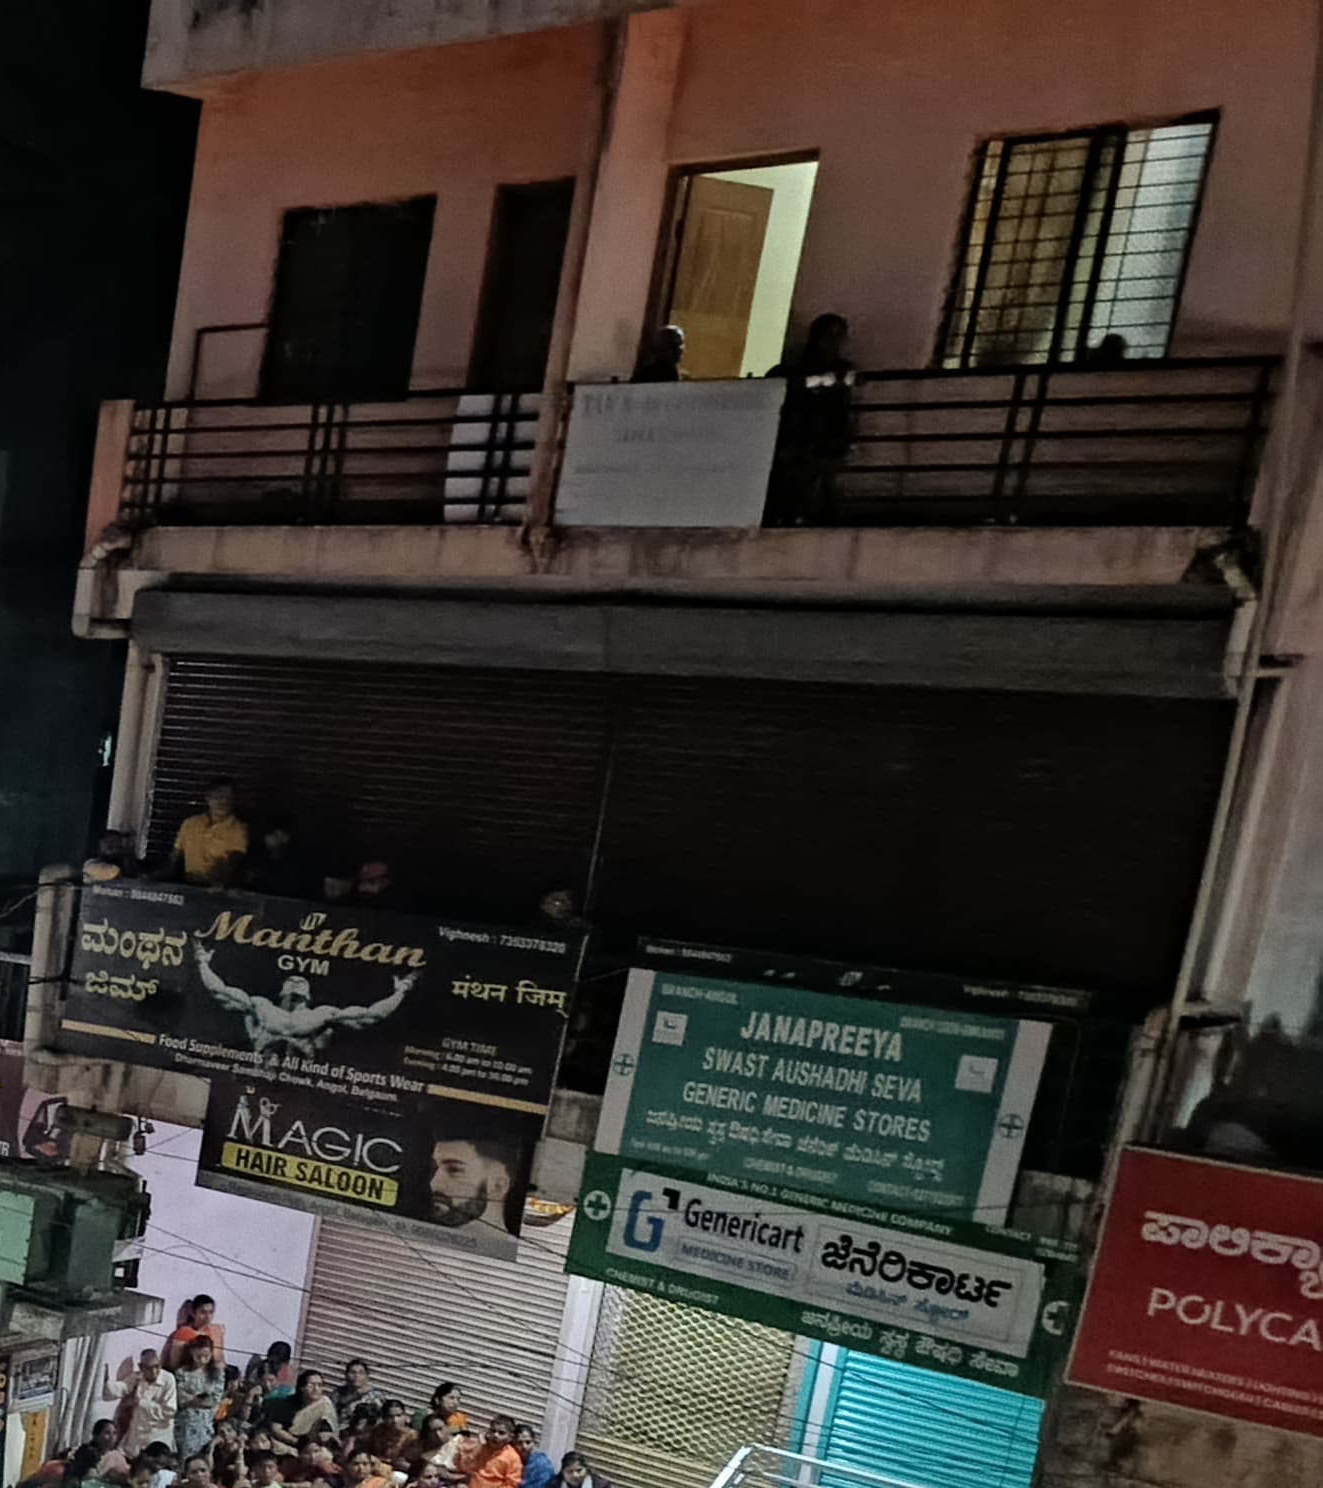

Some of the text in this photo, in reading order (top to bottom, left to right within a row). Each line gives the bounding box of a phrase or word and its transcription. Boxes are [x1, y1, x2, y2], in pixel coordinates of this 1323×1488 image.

[81, 918, 187, 970] ಮಂಥನ
[195, 911, 427, 968] Manthan
[276, 954, 330, 976] GYM
[85, 970, 159, 1001] ಜಿಮ್
[451, 974, 508, 1003] मंथन
[740, 1011, 902, 1062] JANAPREEYA
[159, 1033, 188, 1050] Food
[188, 1039, 264, 1065] Supplements
[282, 1055, 298, 1071] All
[300, 1058, 328, 1078] Kind
[330, 1061, 346, 1078] of
[346, 1066, 387, 1087] Sports
[390, 1074, 426, 1093] Wear
[703, 1047, 922, 1103] SWAST AUSHADHI SEVA
[227, 1095, 403, 1173] MAGIC
[683, 1082, 931, 1142] GENERIC MEDICINE STORES
[235, 1147, 384, 1200] HAIR SALOON
[684, 1199, 805, 1253] Genericart
[891, 1212, 954, 1236] COMPANY
[606, 1267, 655, 1288] CHEMIST
[680, 1242, 791, 1281] MEDICINE STORE
